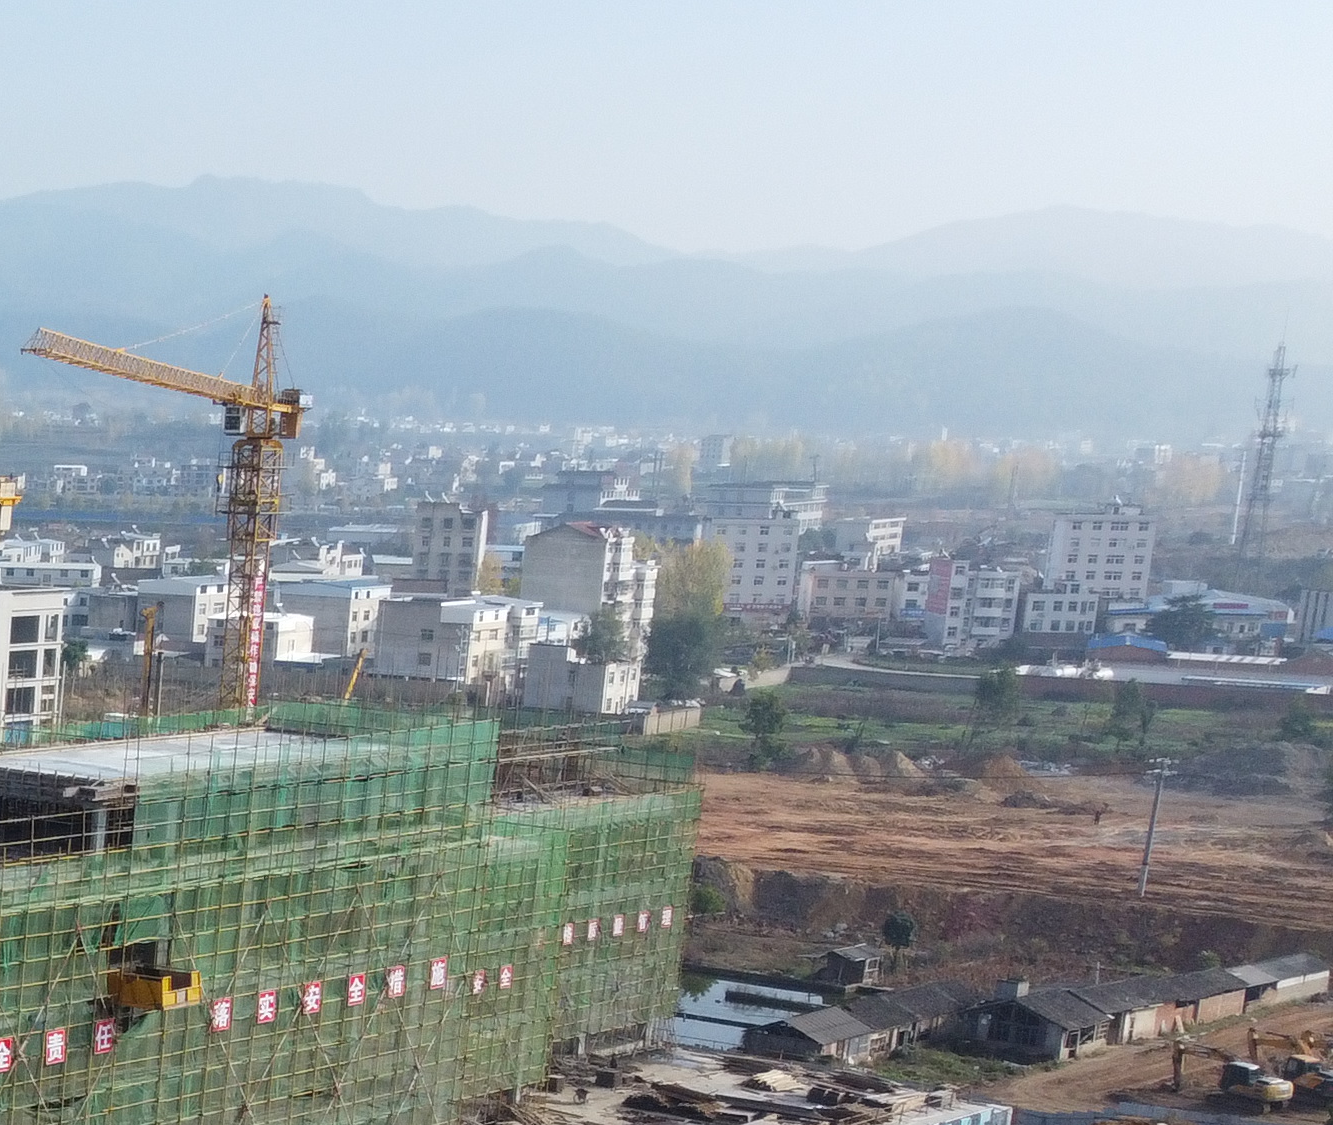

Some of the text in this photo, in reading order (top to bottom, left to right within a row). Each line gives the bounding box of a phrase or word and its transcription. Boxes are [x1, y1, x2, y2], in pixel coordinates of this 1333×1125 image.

[213, 960, 446, 1029] 落实安全措施
